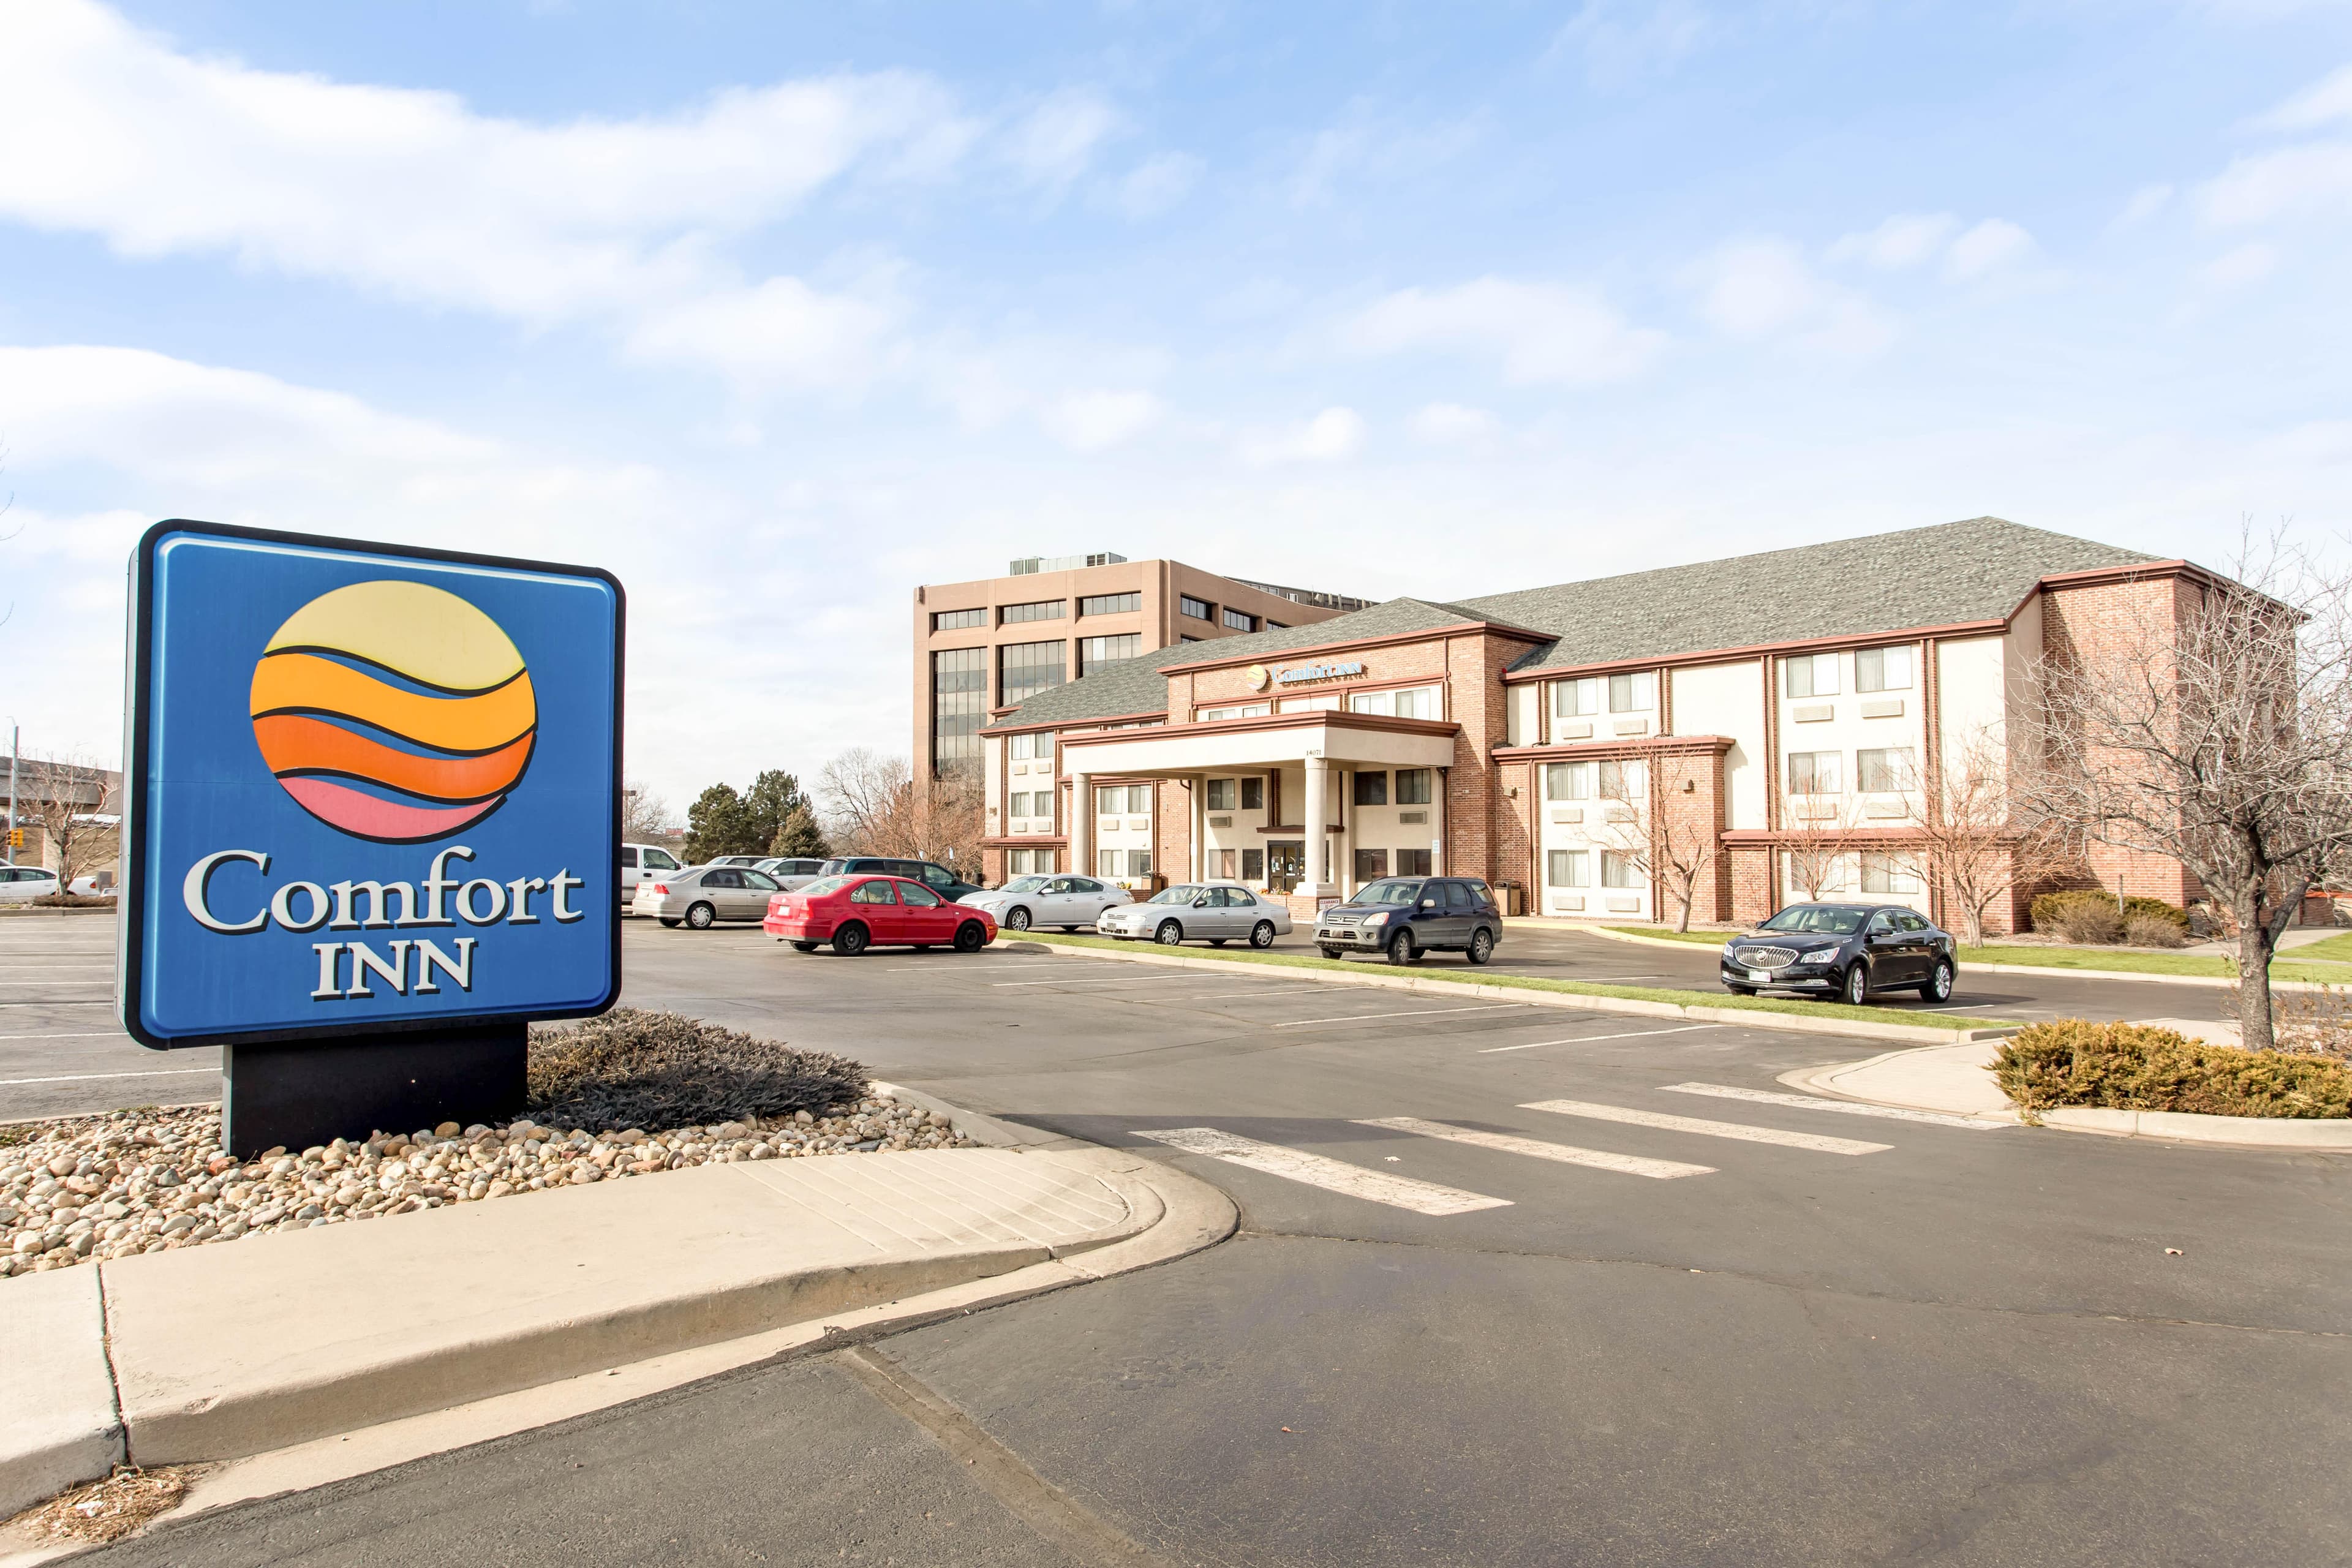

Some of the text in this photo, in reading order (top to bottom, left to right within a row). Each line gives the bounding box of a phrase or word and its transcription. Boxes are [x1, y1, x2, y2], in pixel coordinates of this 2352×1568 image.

[1271, 661, 1362, 683] Comfort INN
[183, 845, 583, 931] Comfort
[311, 937, 475, 997] INN
